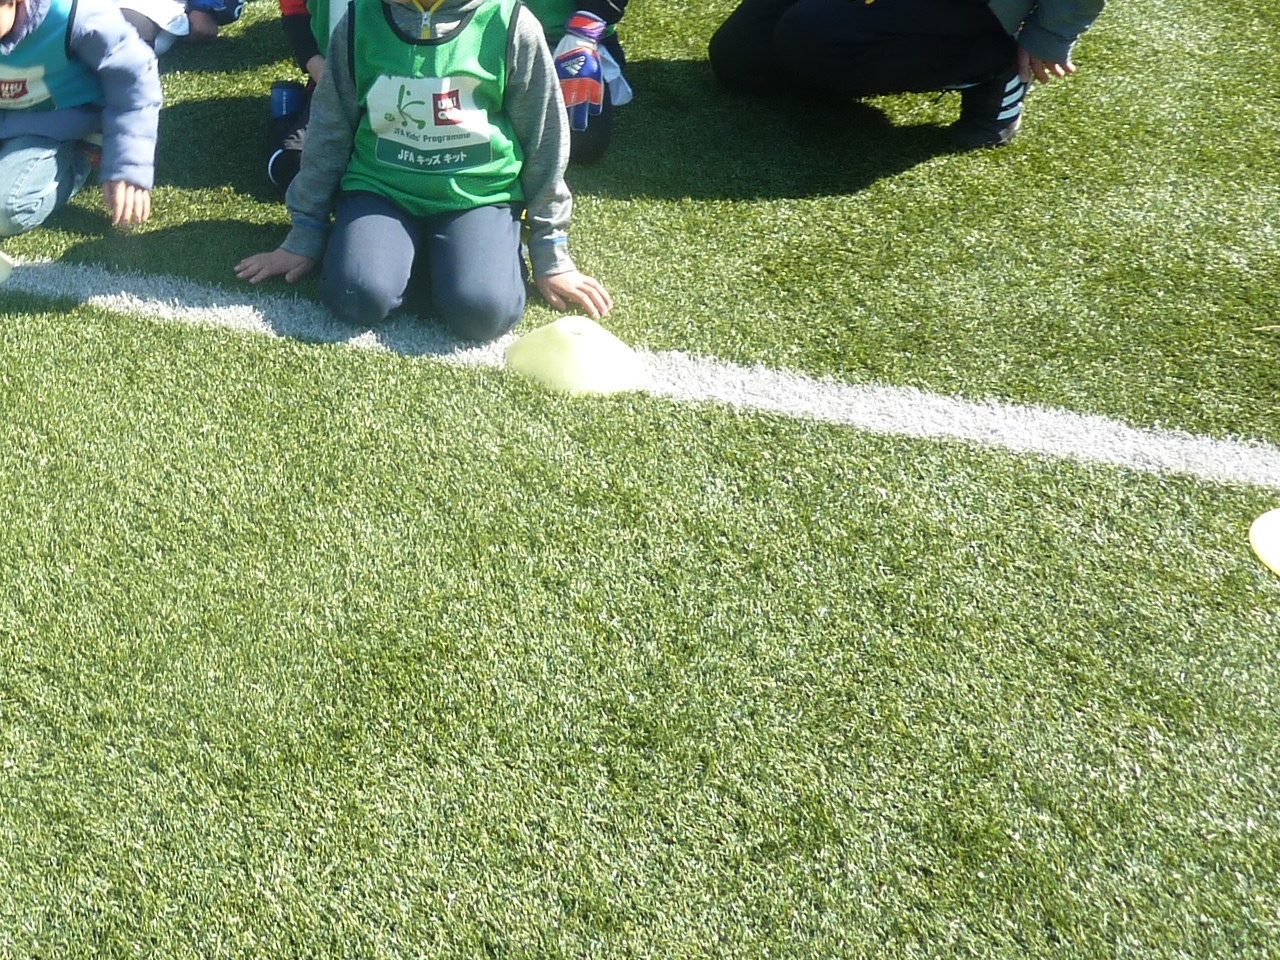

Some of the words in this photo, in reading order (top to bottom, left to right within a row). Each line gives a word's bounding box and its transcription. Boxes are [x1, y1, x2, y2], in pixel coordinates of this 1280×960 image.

[437, 96, 457, 109] UNI
[394, 127, 405, 138] JFA
[406, 130, 421, 142] Kids'
[423, 132, 471, 144] Programme
[397, 149, 415, 163] JFA
[416, 153, 441, 166] キッズ
[443, 151, 467, 165] キット
